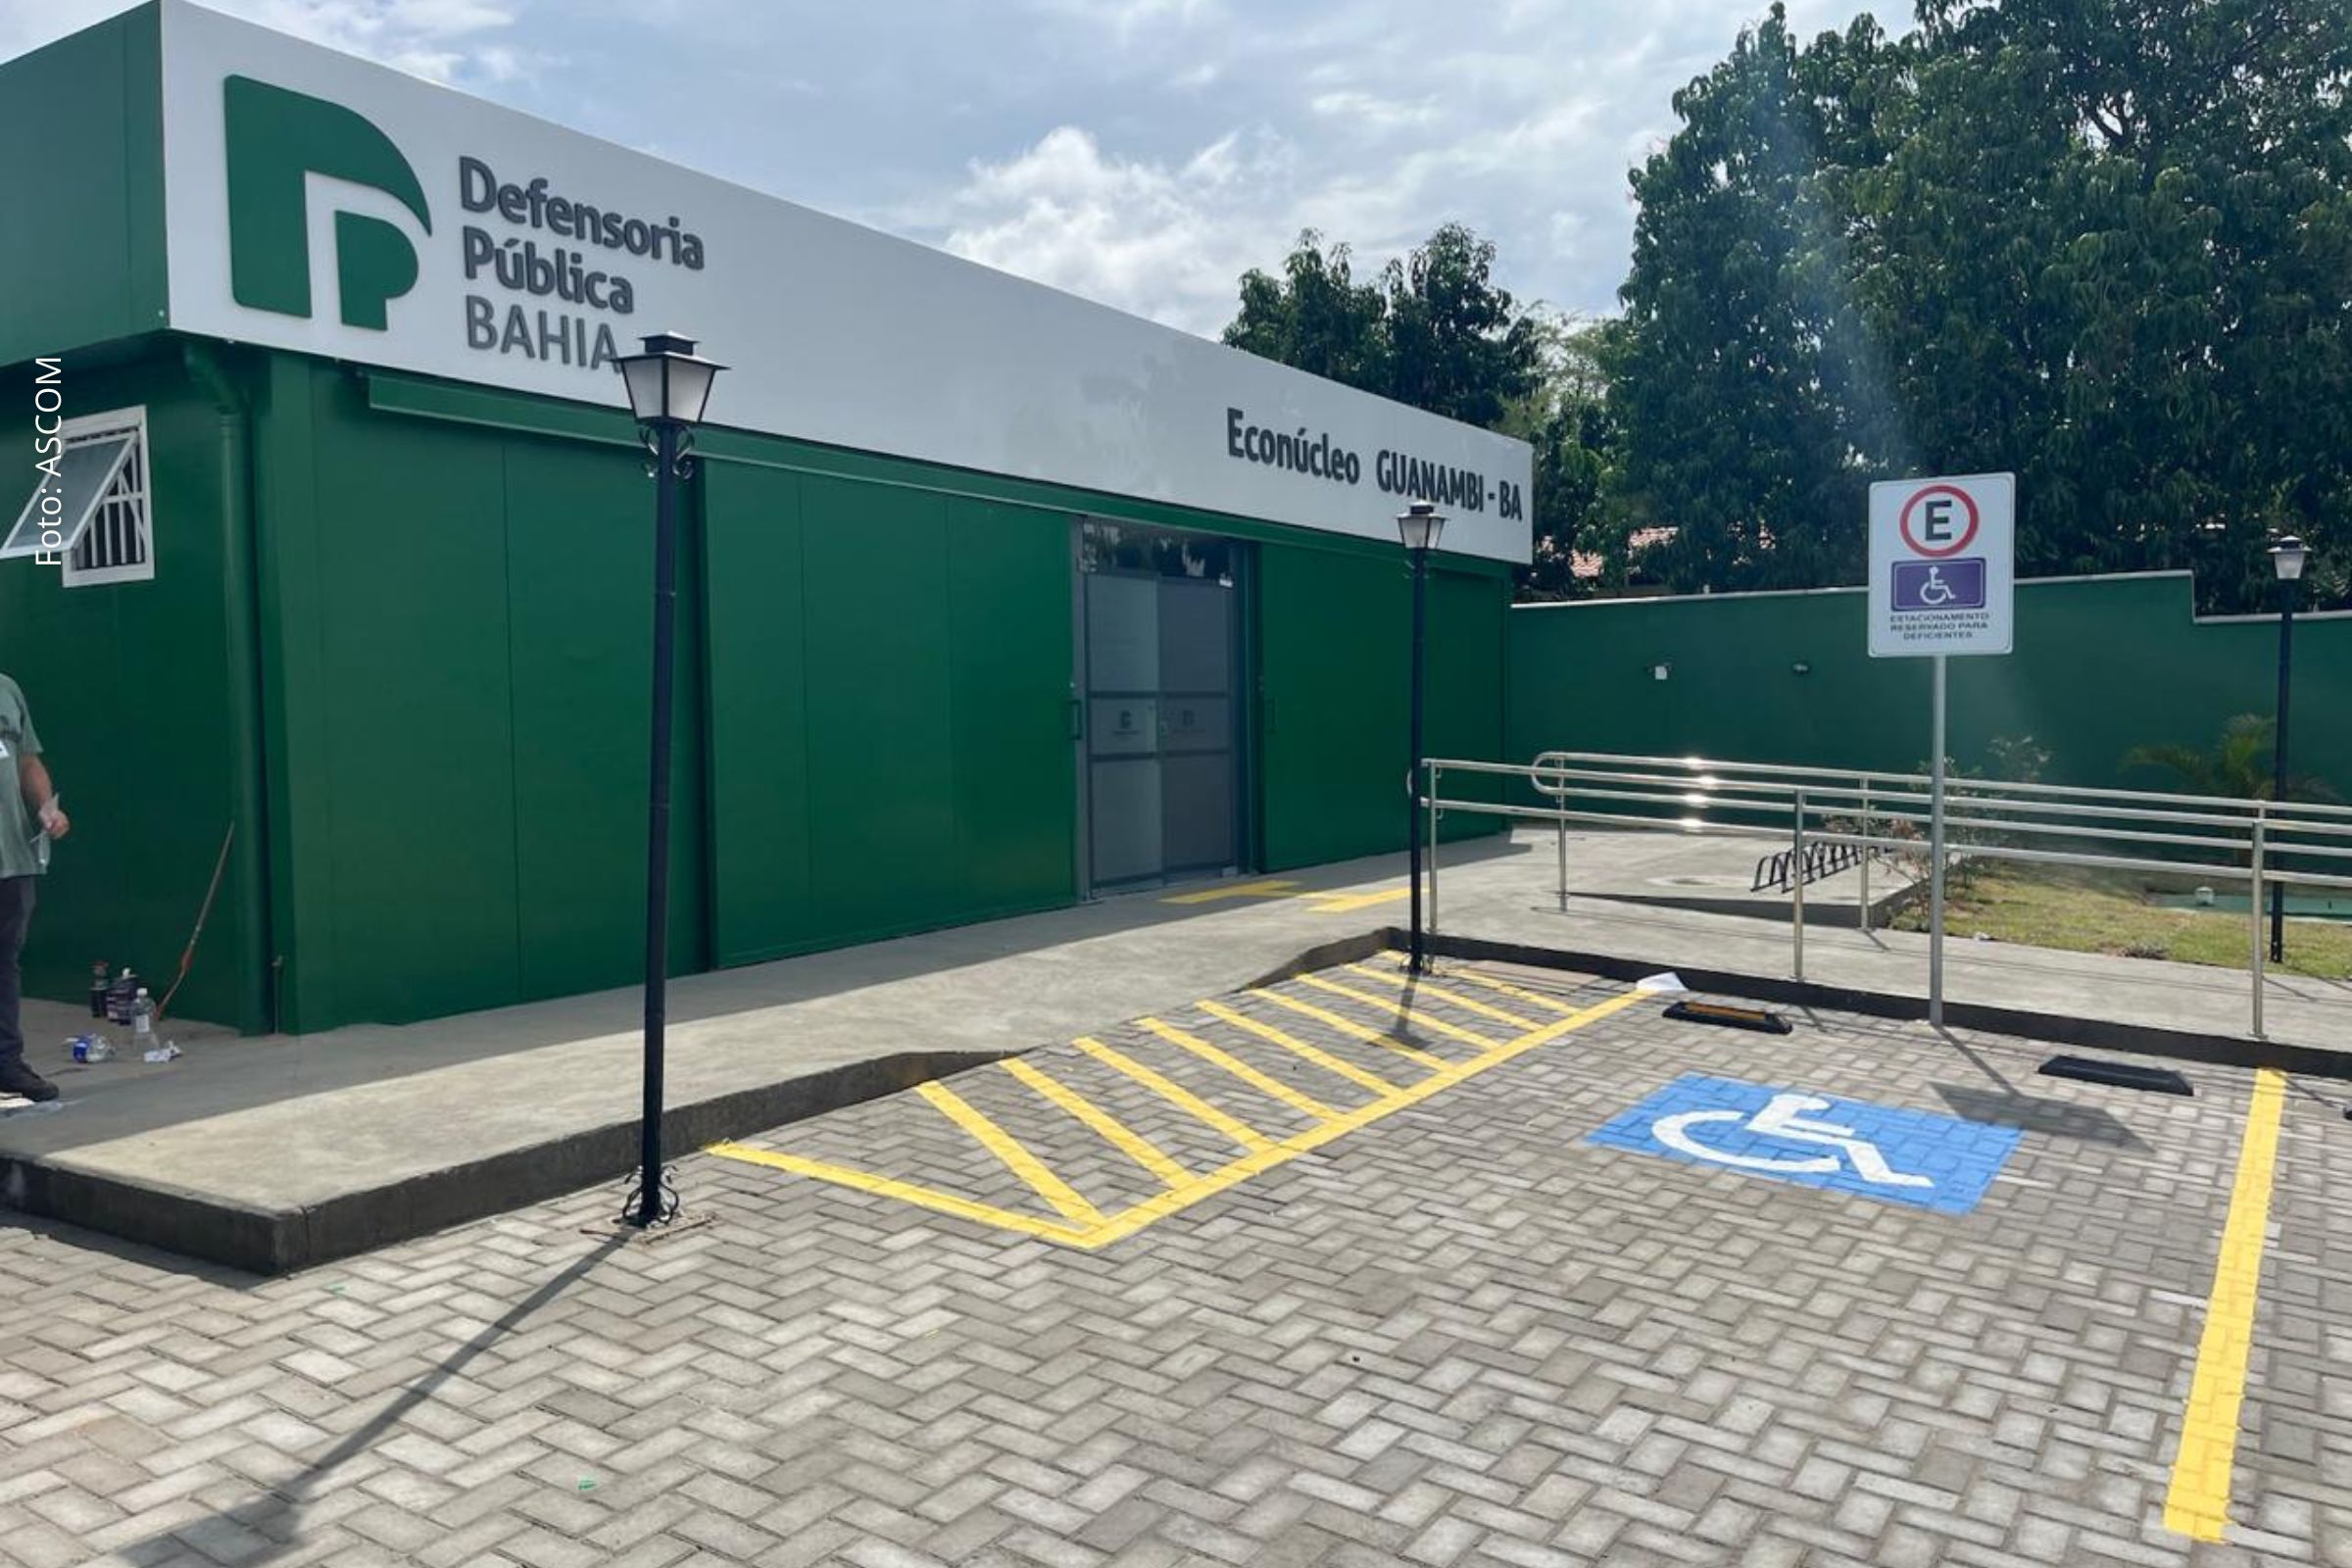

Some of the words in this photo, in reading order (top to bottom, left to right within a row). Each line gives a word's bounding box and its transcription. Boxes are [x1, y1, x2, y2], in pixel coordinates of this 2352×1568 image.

[459, 155, 704, 270] Defensoria
[463, 225, 633, 314] Pública
[466, 295, 621, 373] BAHIA
[1227, 408, 1360, 485] Econúcleo
[1925, 500, 1952, 541] E
[1890, 612, 1989, 623] ESTACIONAMENTO
[1890, 623, 1956, 632] RESERVADO
[1903, 631, 1974, 641] DEFICIENTES
